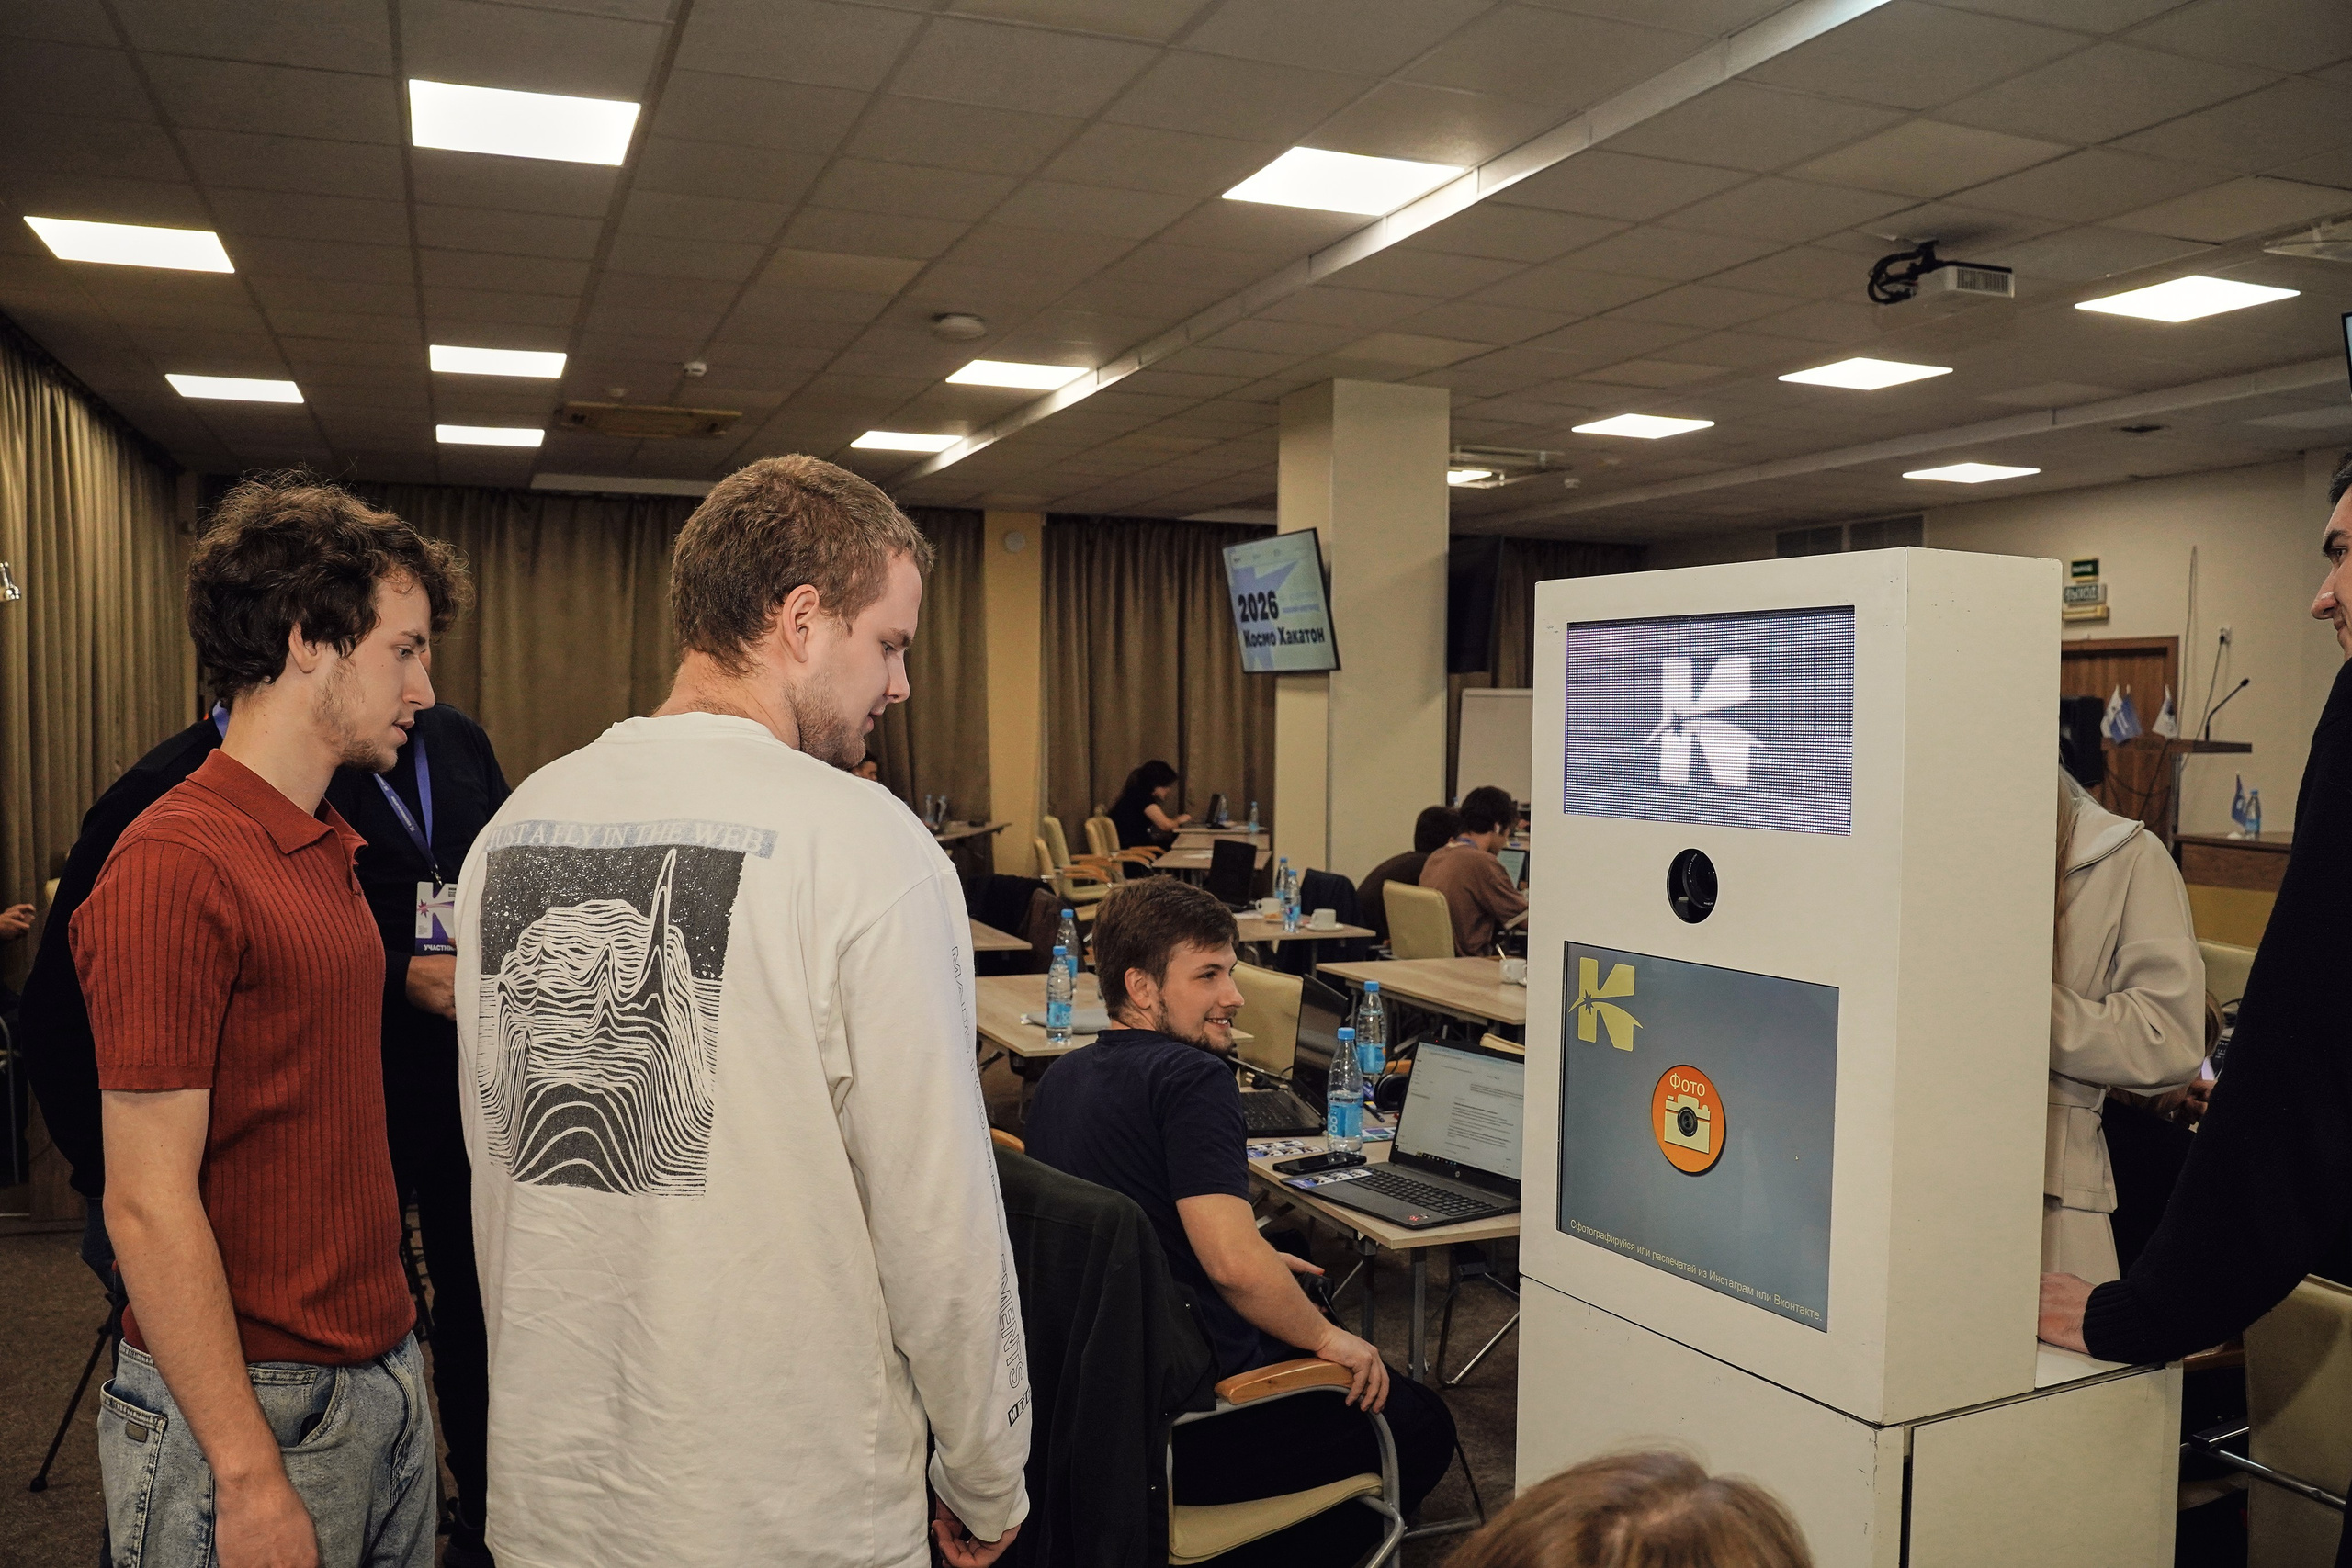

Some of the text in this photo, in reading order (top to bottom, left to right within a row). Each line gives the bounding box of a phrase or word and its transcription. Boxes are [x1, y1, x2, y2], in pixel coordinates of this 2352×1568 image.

[1238, 590, 1280, 623] 2026
[1243, 626, 1326, 649] Космо Хакатон
[486, 823, 764, 853] JUST A FLY IN THE WEB
[1669, 1072, 1706, 1097] Фото
[1570, 1219, 1822, 1322] Сфотографируйся или распечатай из Инстаграм или Вконтакте.
